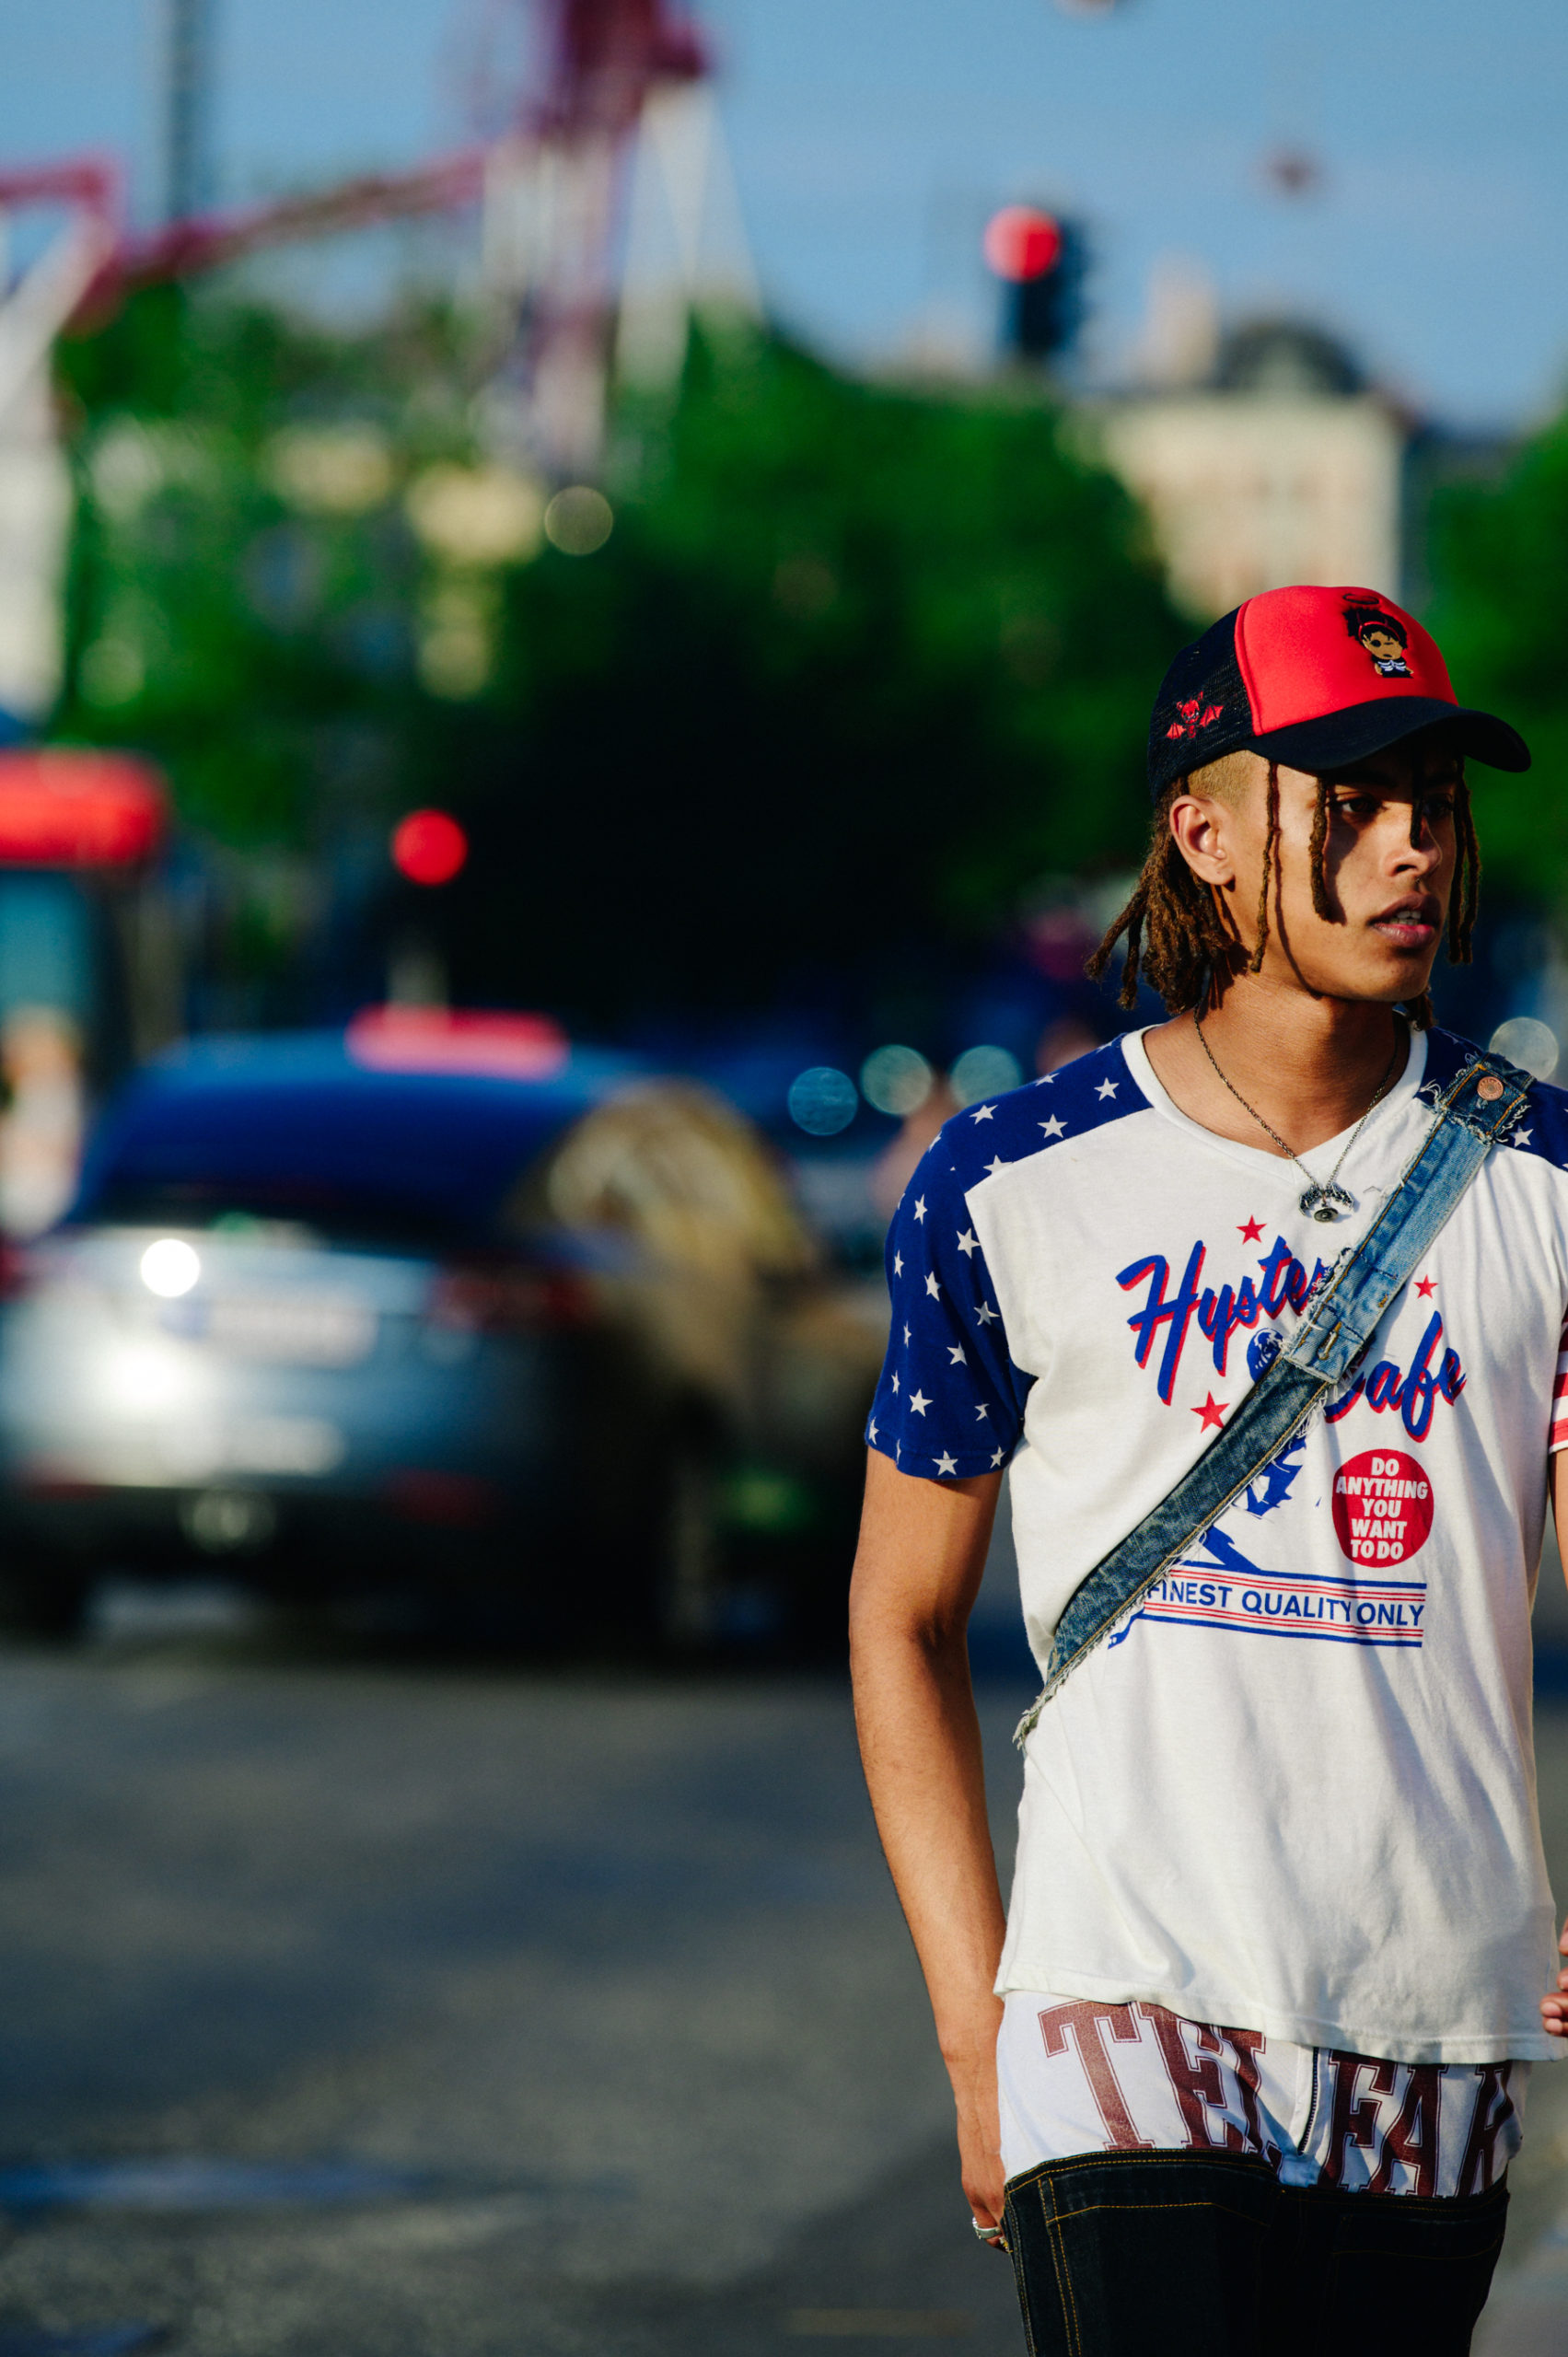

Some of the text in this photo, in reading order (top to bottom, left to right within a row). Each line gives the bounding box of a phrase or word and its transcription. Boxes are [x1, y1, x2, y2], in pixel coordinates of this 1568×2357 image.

[1371, 1457, 1400, 1477] DO
[1336, 1476, 1428, 1500] ANYTHING
[1362, 1498, 1401, 1518] YOU
[1351, 1518, 1407, 1539] WANT
[1351, 1539, 1404, 1561] TO DO
[1242, 1590, 1351, 1622] QUALITY
[1356, 1602, 1424, 1626] ONLY
